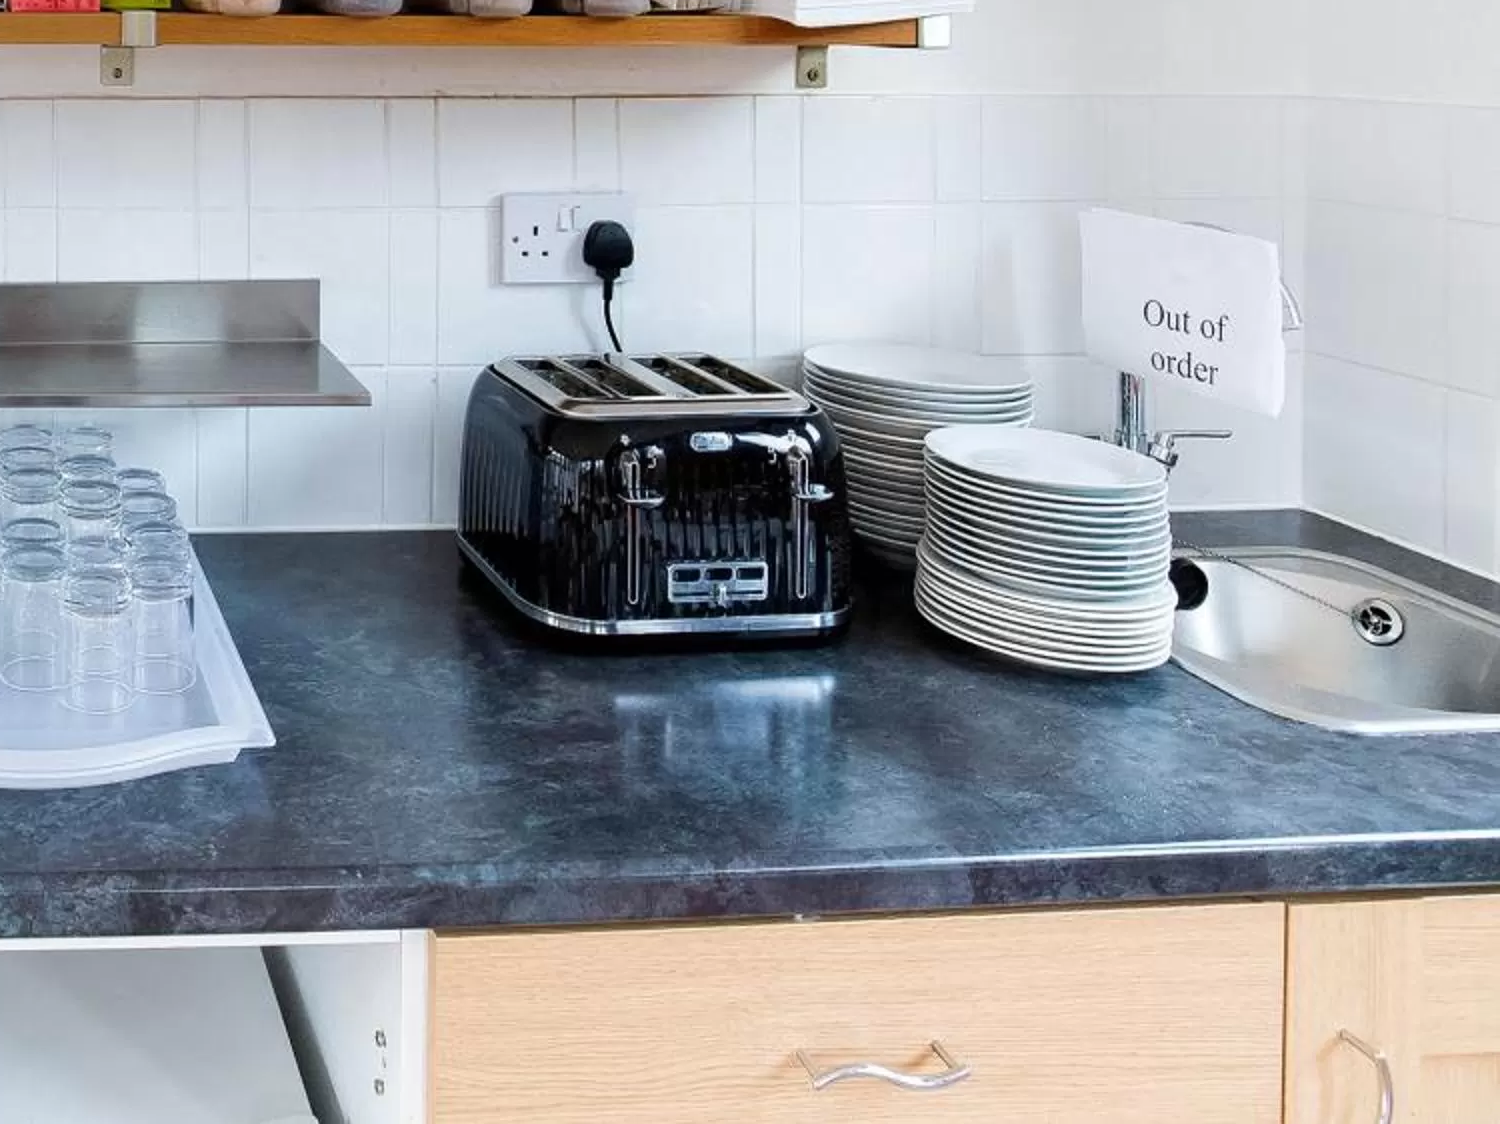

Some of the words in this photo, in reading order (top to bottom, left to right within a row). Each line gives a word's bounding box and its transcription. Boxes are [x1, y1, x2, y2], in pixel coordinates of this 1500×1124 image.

[1143, 299, 1191, 335] Out
[1200, 315, 1229, 343] of
[1151, 351, 1219, 385] order
